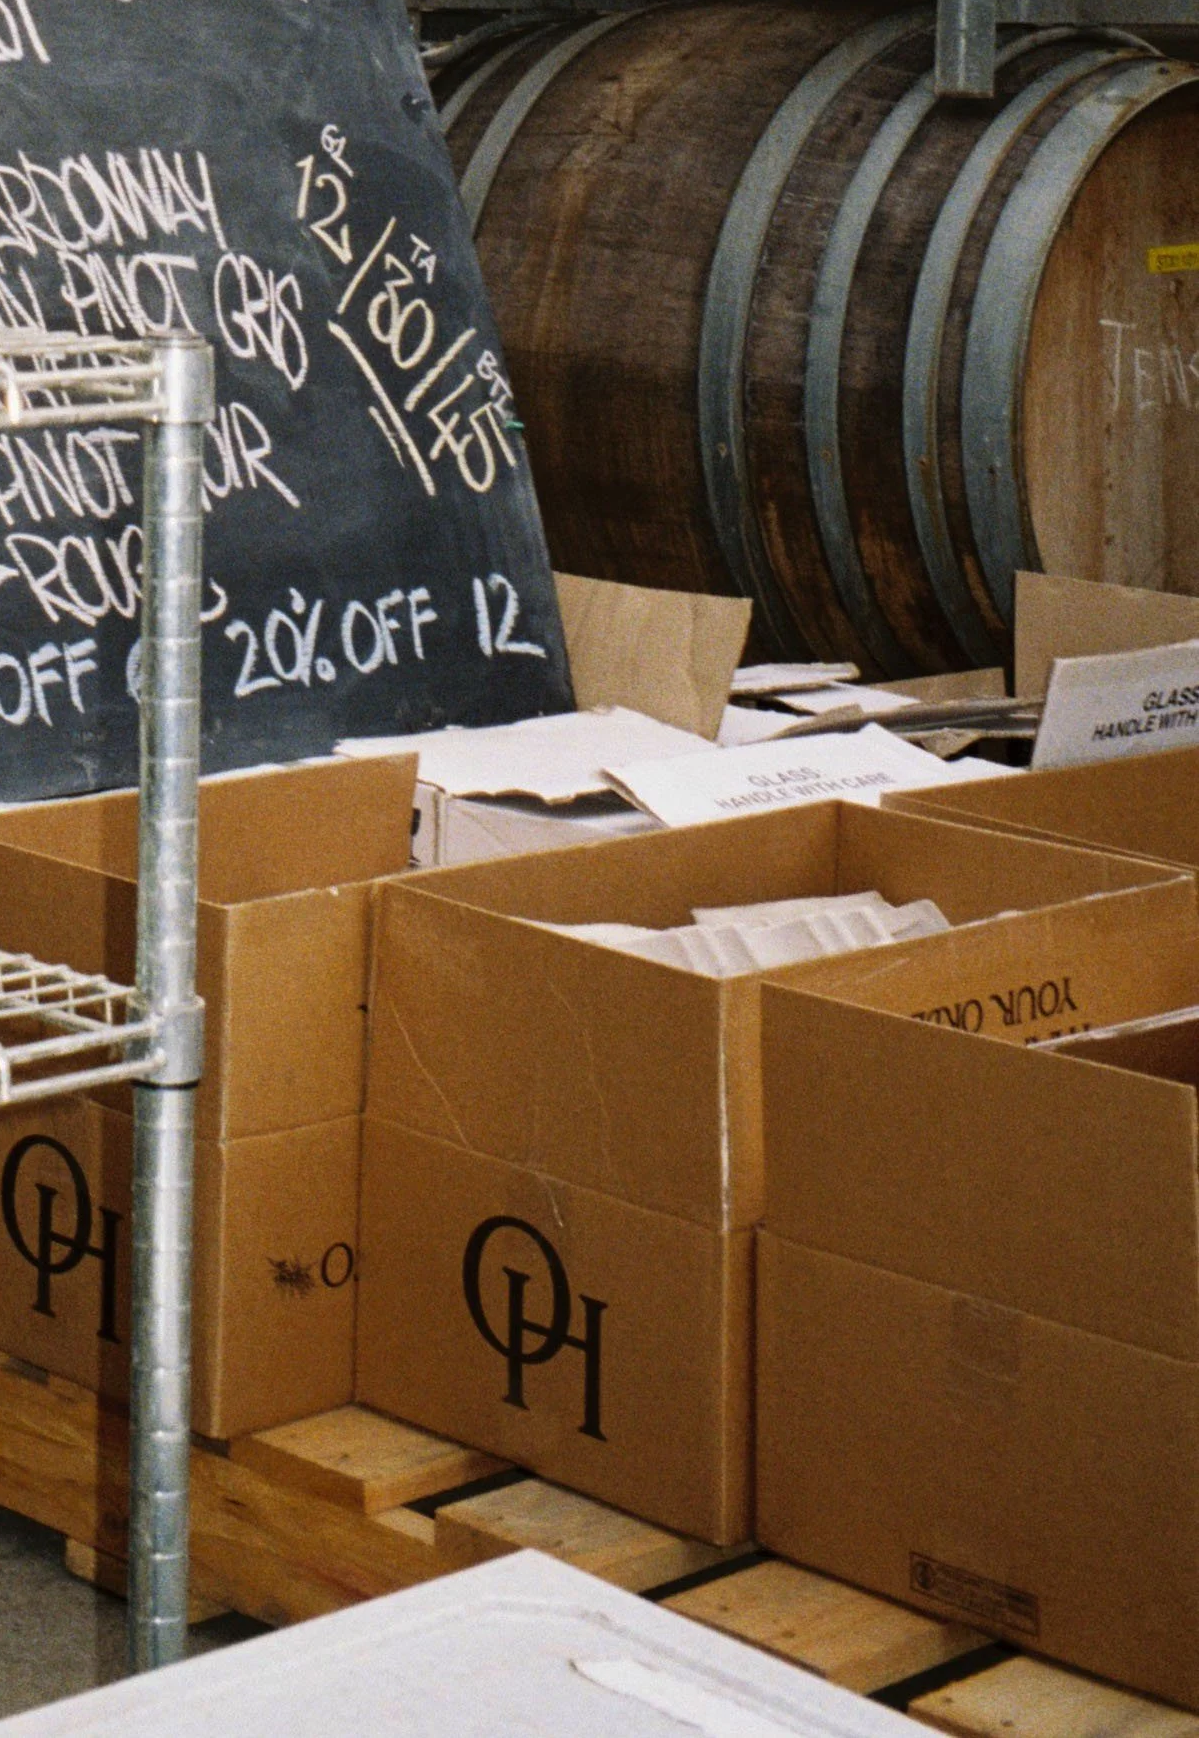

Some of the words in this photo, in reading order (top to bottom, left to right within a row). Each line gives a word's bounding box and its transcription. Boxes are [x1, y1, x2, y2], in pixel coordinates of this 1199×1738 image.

[59, 250, 200, 338] PINOT
[213, 252, 309, 391] GRIS
[409, 233, 437, 284] TA
[475, 349, 515, 421] BTL
[225, 589, 337, 698] 20%
[340, 586, 439, 673] OFF
[471, 574, 547, 658] 12
[1091, 718, 1157, 741] HANDLE
[1158, 709, 1199, 731] WITH
[714, 788, 792, 810] HANDLE
[792, 778, 842, 798] WITH
[842, 772, 895, 790] CARE
[989, 976, 1079, 1027] YOUR
[462, 1214, 608, 1442] OH
